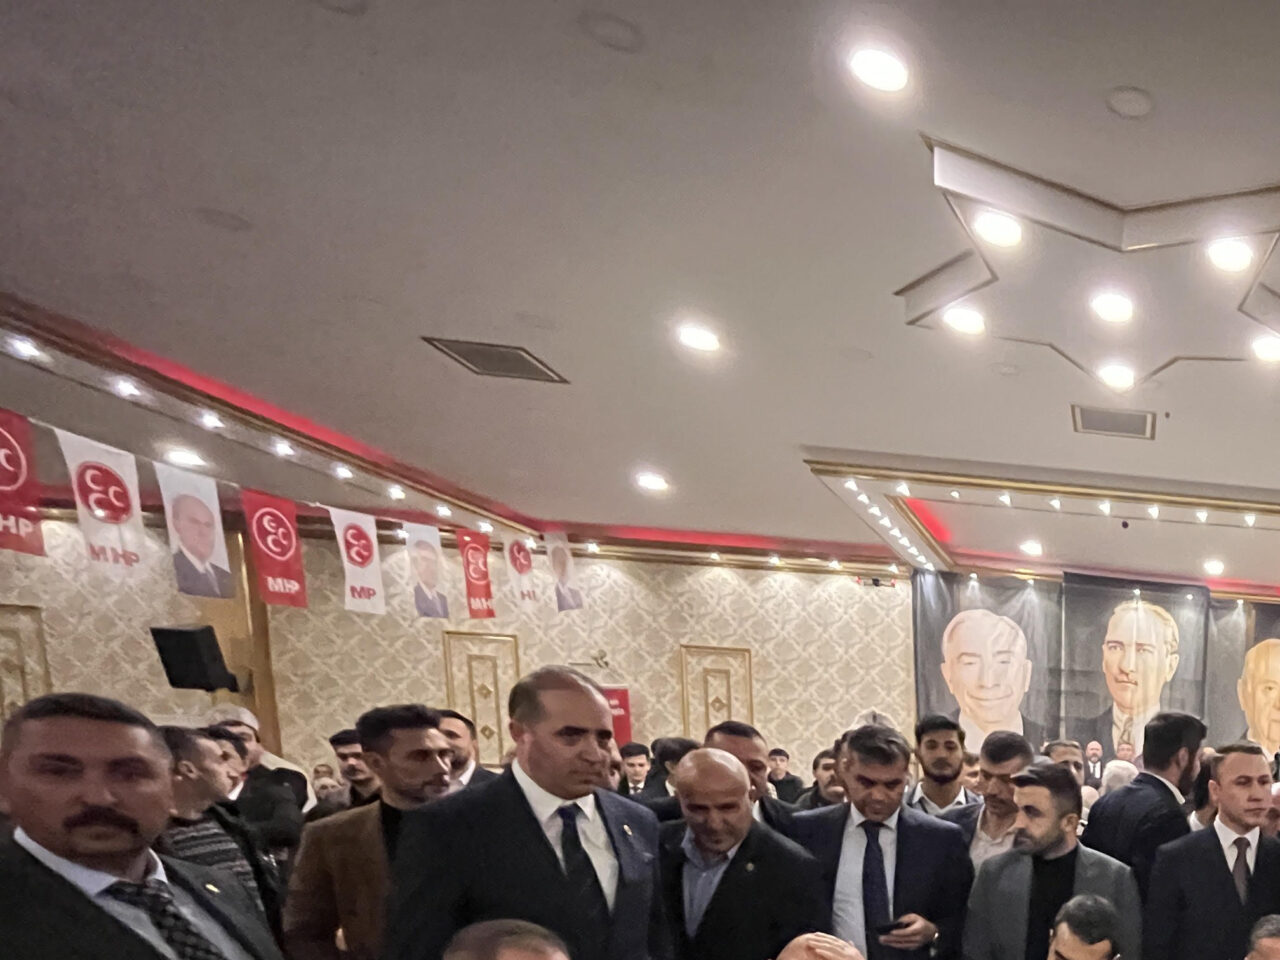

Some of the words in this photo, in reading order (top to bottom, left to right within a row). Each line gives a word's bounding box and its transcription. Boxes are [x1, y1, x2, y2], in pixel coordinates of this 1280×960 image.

[0, 512, 34, 537] HP
[88, 542, 140, 568] MHP
[350, 584, 376, 600] MP
